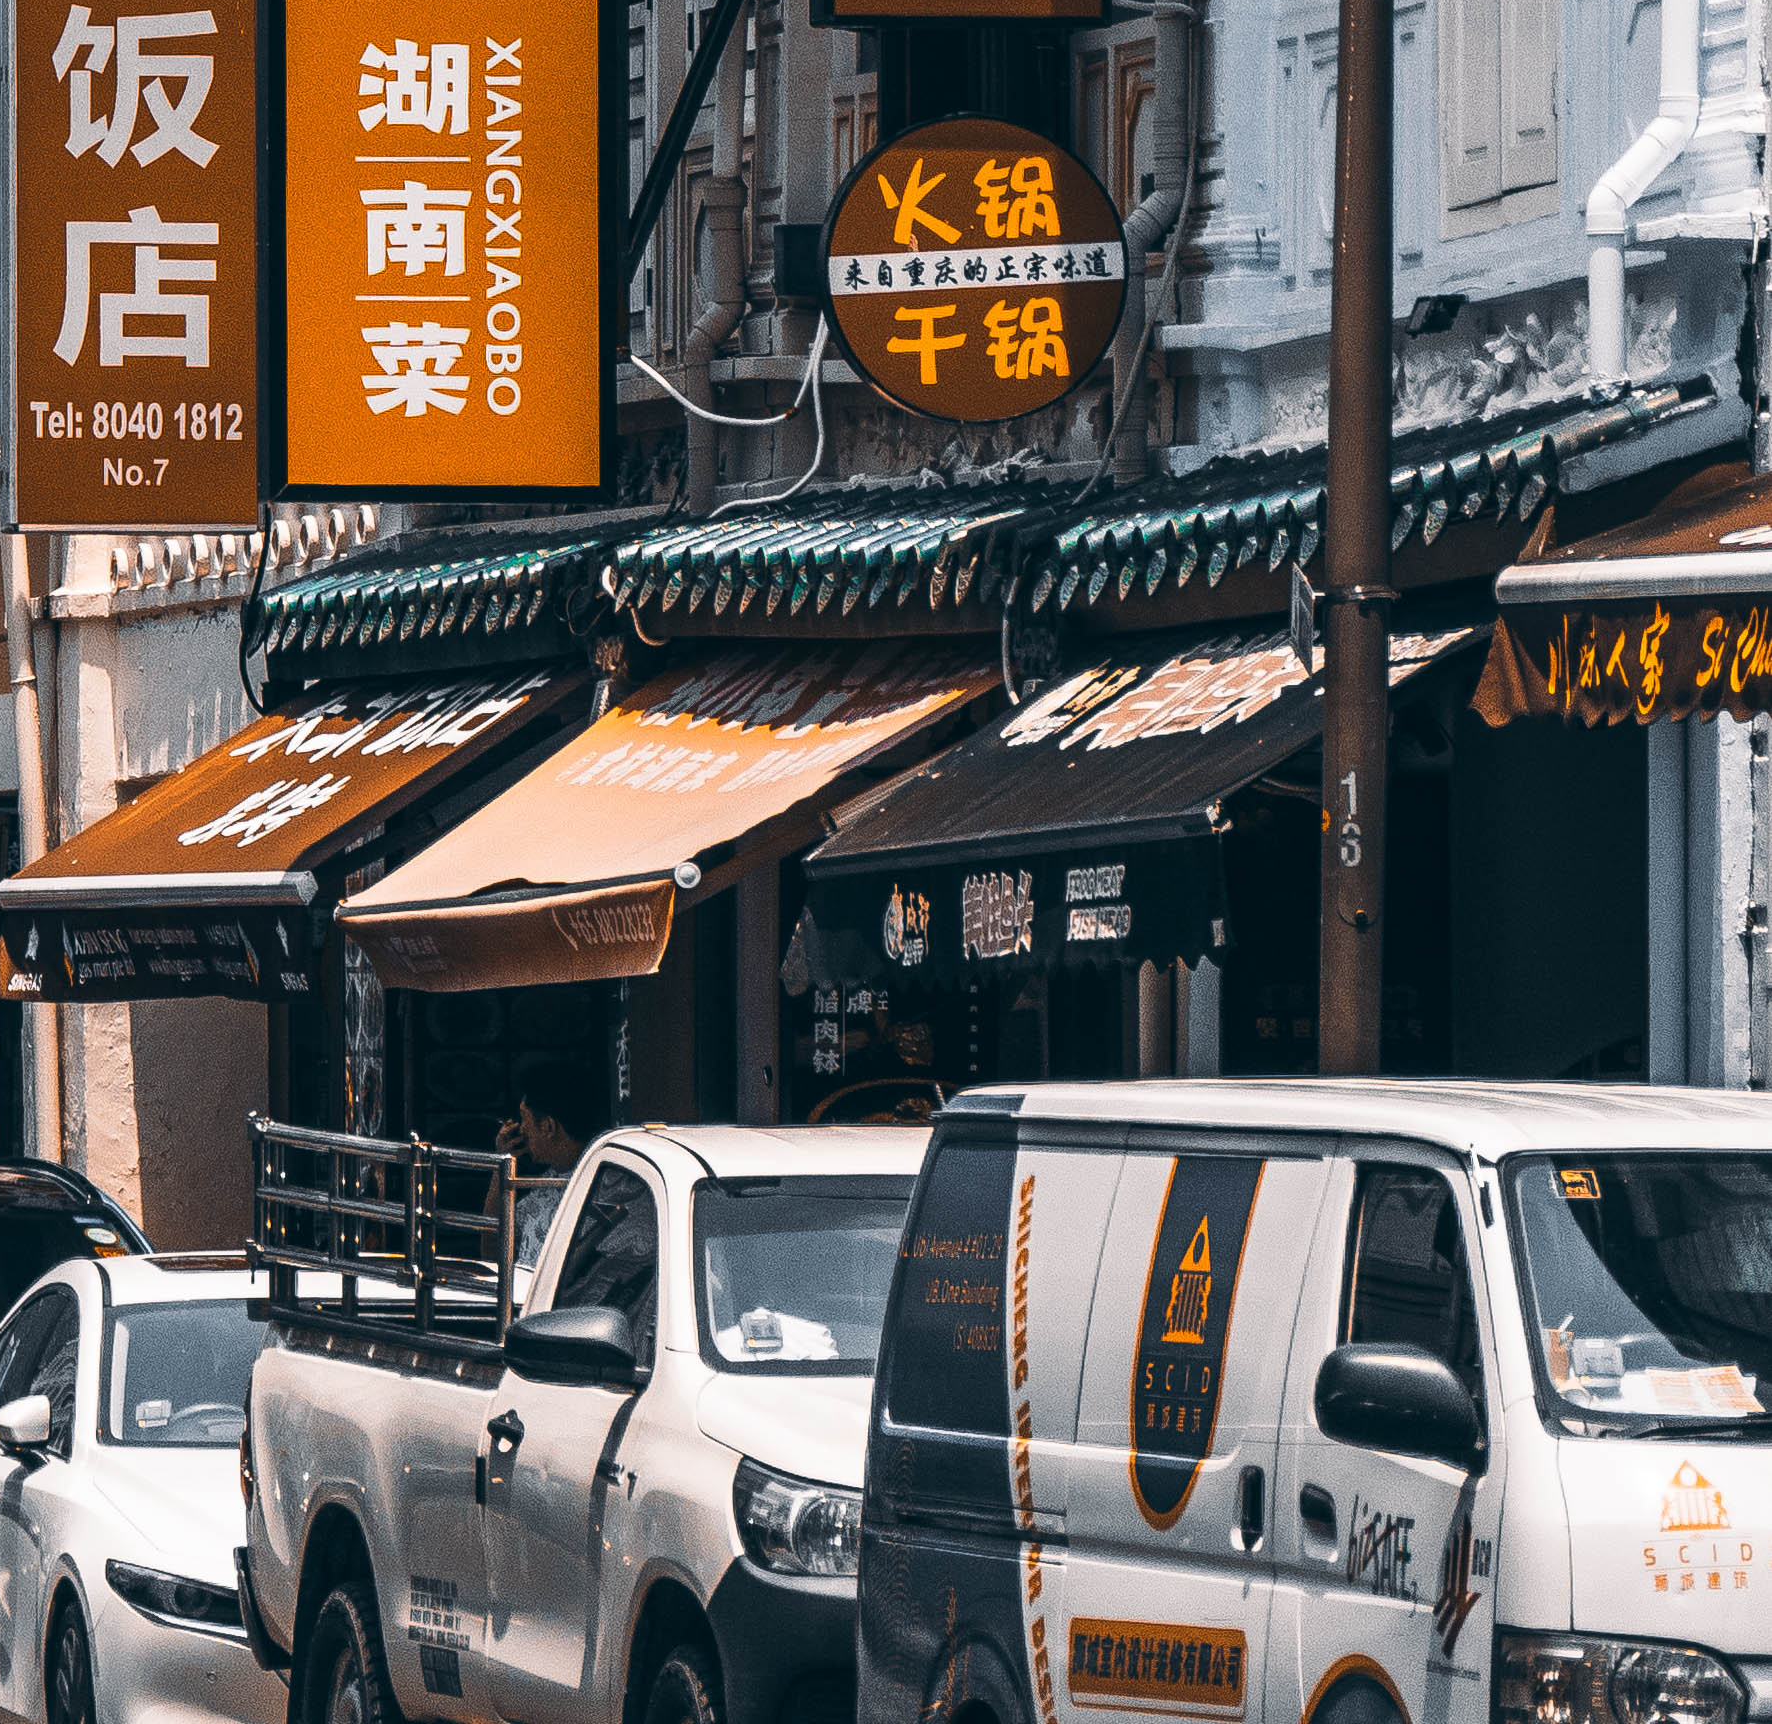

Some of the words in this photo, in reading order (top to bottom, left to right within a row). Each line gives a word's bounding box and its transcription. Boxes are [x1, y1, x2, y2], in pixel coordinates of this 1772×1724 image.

[357, 39, 472, 418] 湖南菜
[485, 39, 522, 416] XIANGXIAOBO
[878, 156, 1061, 244] 火锅
[844, 247, 1113, 288] 来自重庆的正宗味道
[887, 296, 1070, 384] 干锅
[30, 401, 83, 441] Tel:
[92, 402, 165, 443] 8040
[173, 404, 243, 444] 1812
[102, 456, 171, 486] No.7
